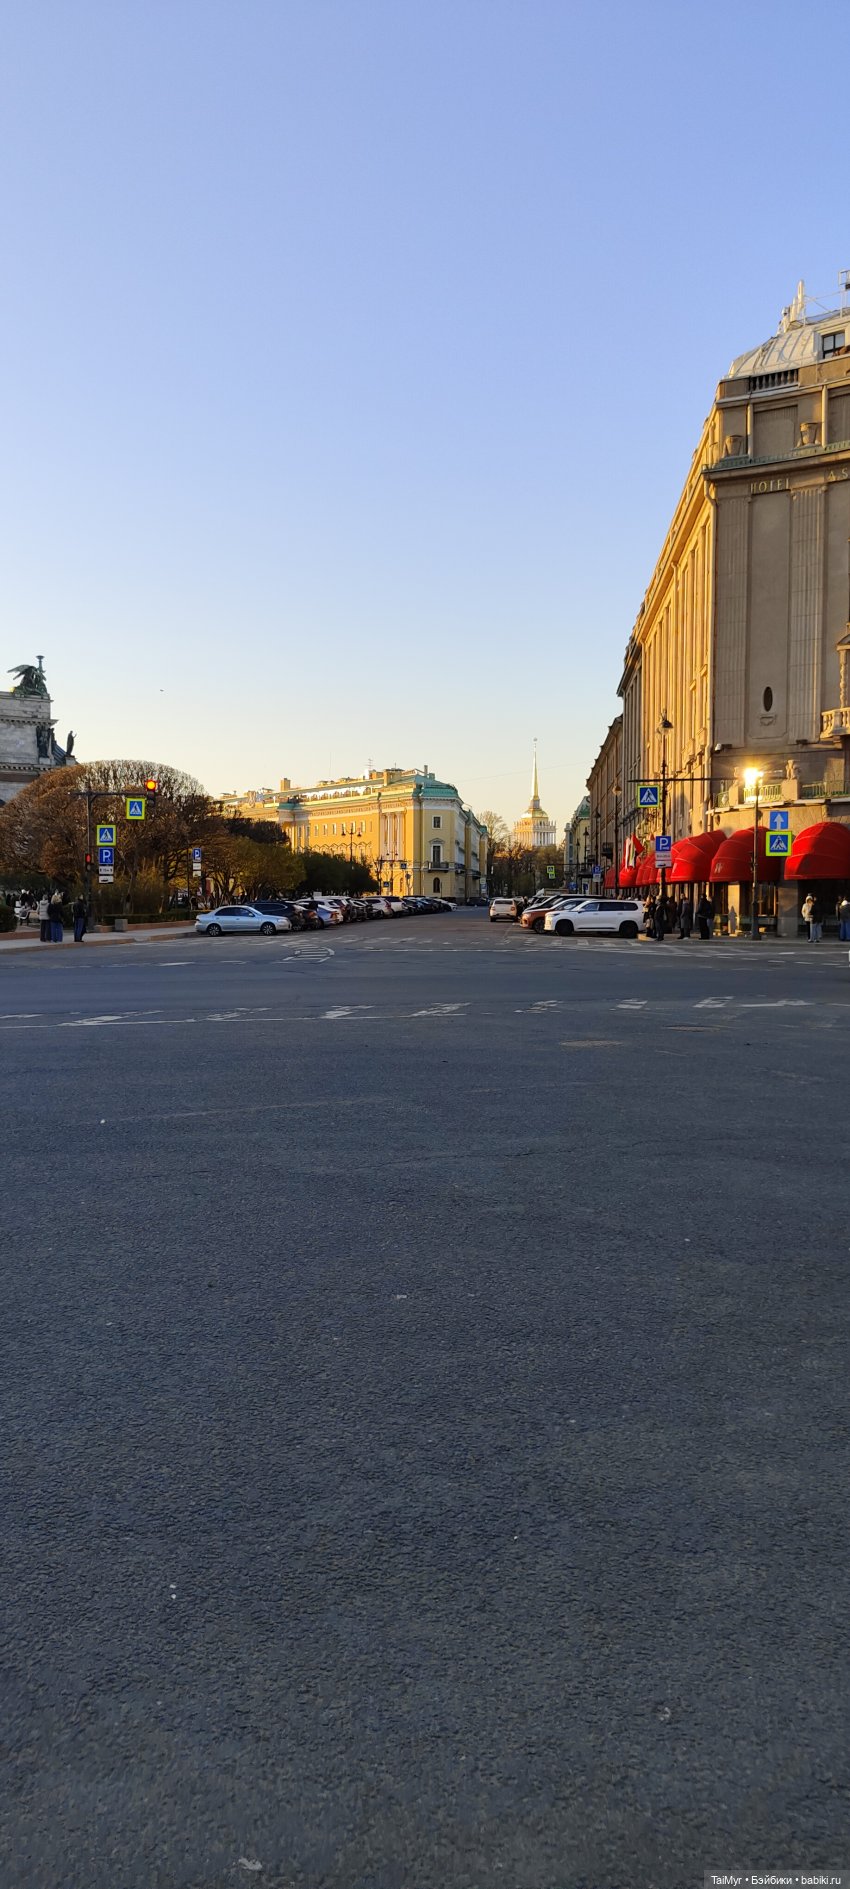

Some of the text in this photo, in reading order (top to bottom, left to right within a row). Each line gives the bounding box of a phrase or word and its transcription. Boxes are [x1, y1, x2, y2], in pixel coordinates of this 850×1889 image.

[750, 478, 790, 493] HOTEL
[659, 838, 669, 850] P
[102, 849, 111, 862] P
[194, 850, 200, 860] P
